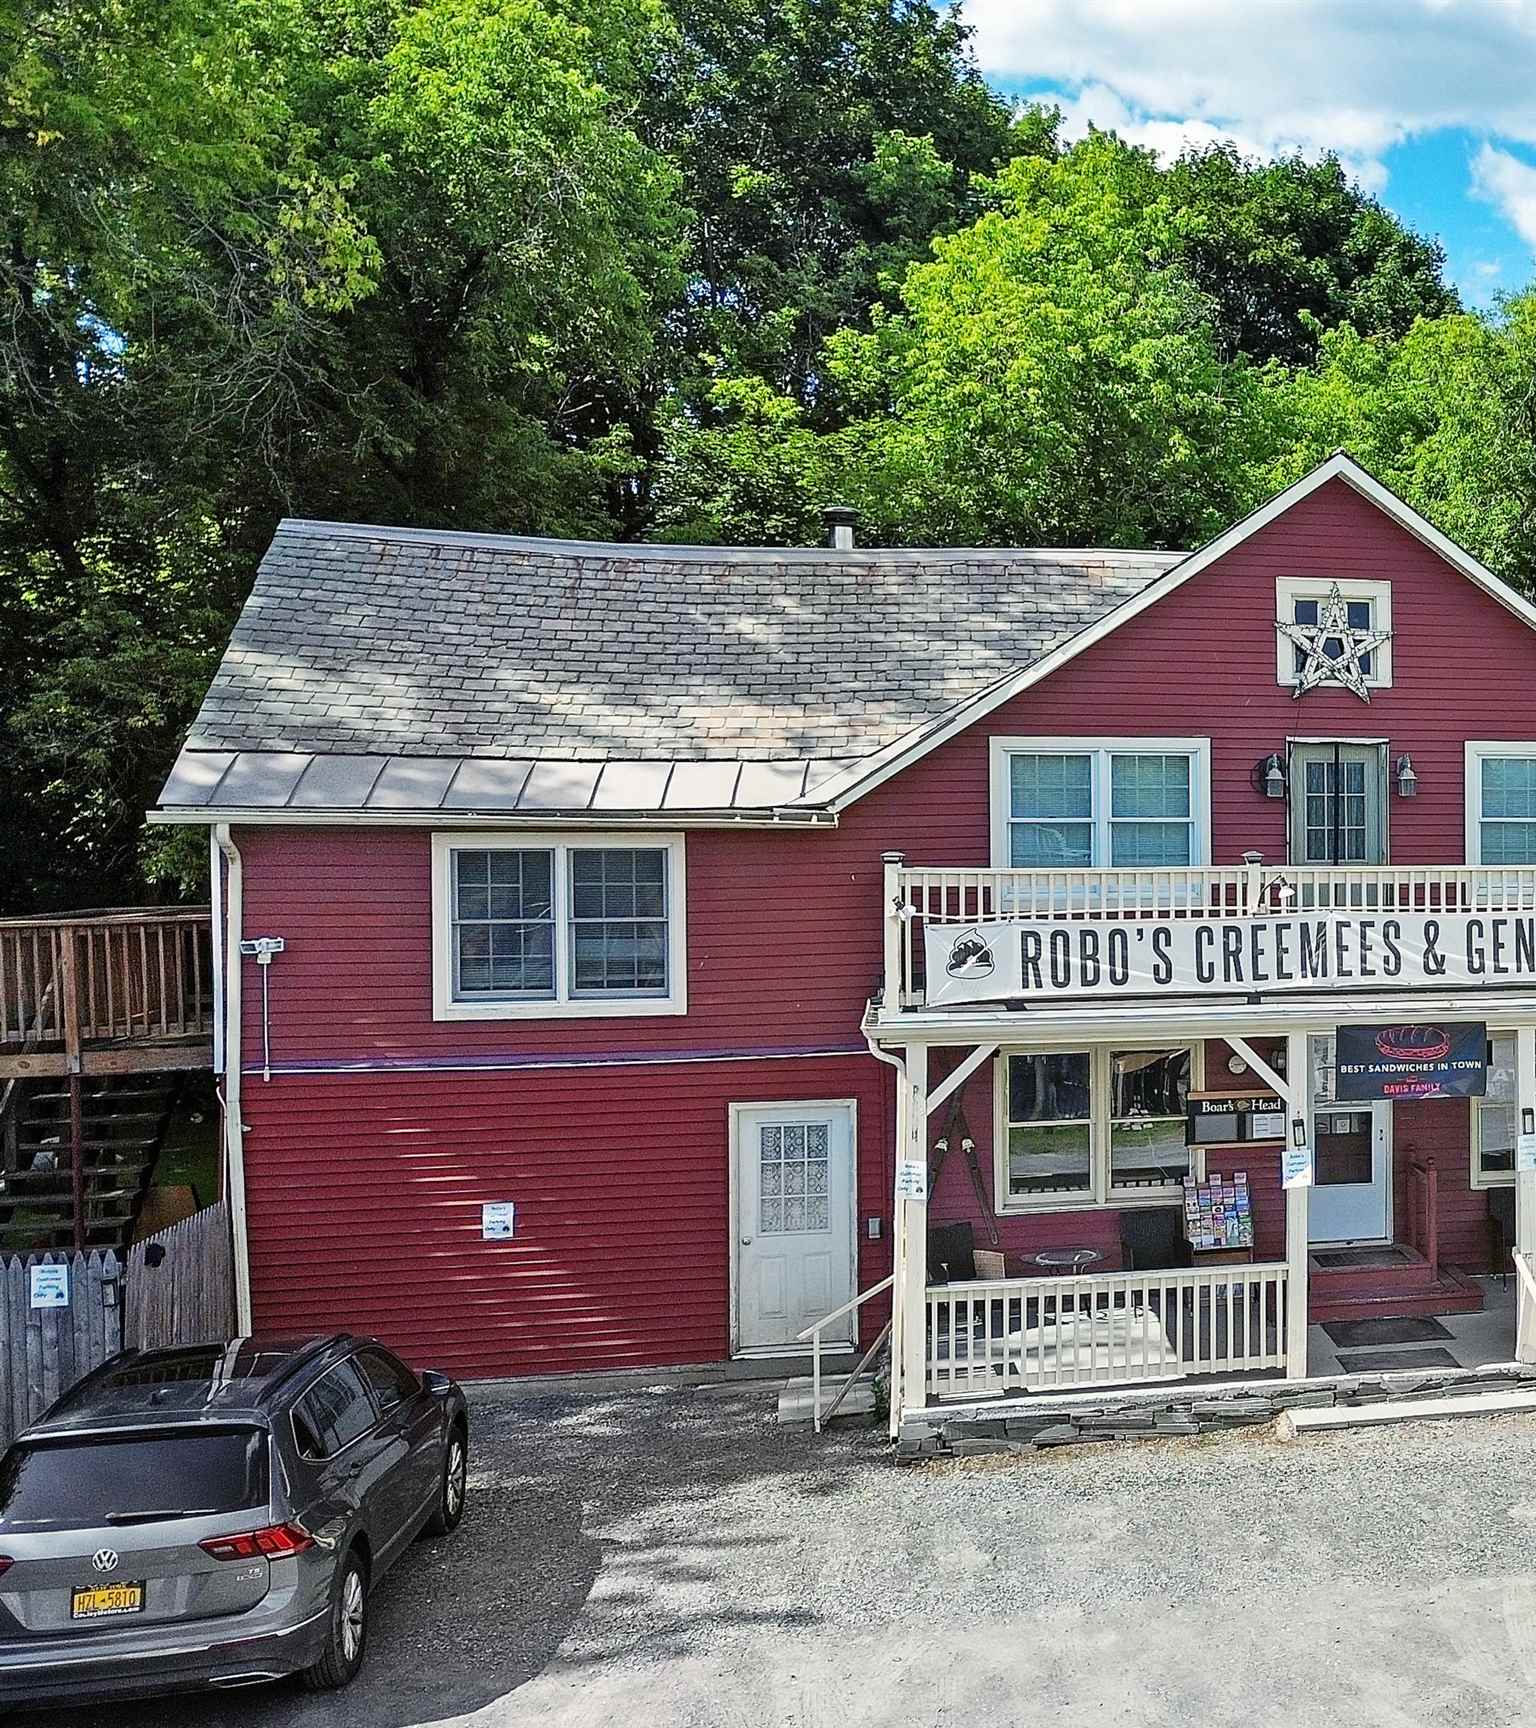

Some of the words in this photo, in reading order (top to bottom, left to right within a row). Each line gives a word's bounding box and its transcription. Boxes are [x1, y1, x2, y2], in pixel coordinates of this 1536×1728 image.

[1021, 925, 1173, 990] ROBO'S
[1195, 920, 1401, 983] CREEMEES
[1423, 919, 1446, 976] &
[1340, 1064, 1365, 1074] BEST
[1368, 1063, 1434, 1073] SANDWICHES
[1437, 1062, 1448, 1071] IN
[1453, 1061, 1481, 1069] TOWN
[1383, 1084, 1409, 1095] DAVIS
[1411, 1083, 1441, 1093] FAMILY
[1202, 1100, 1234, 1113] Boar's
[1251, 1098, 1281, 1110] Head
